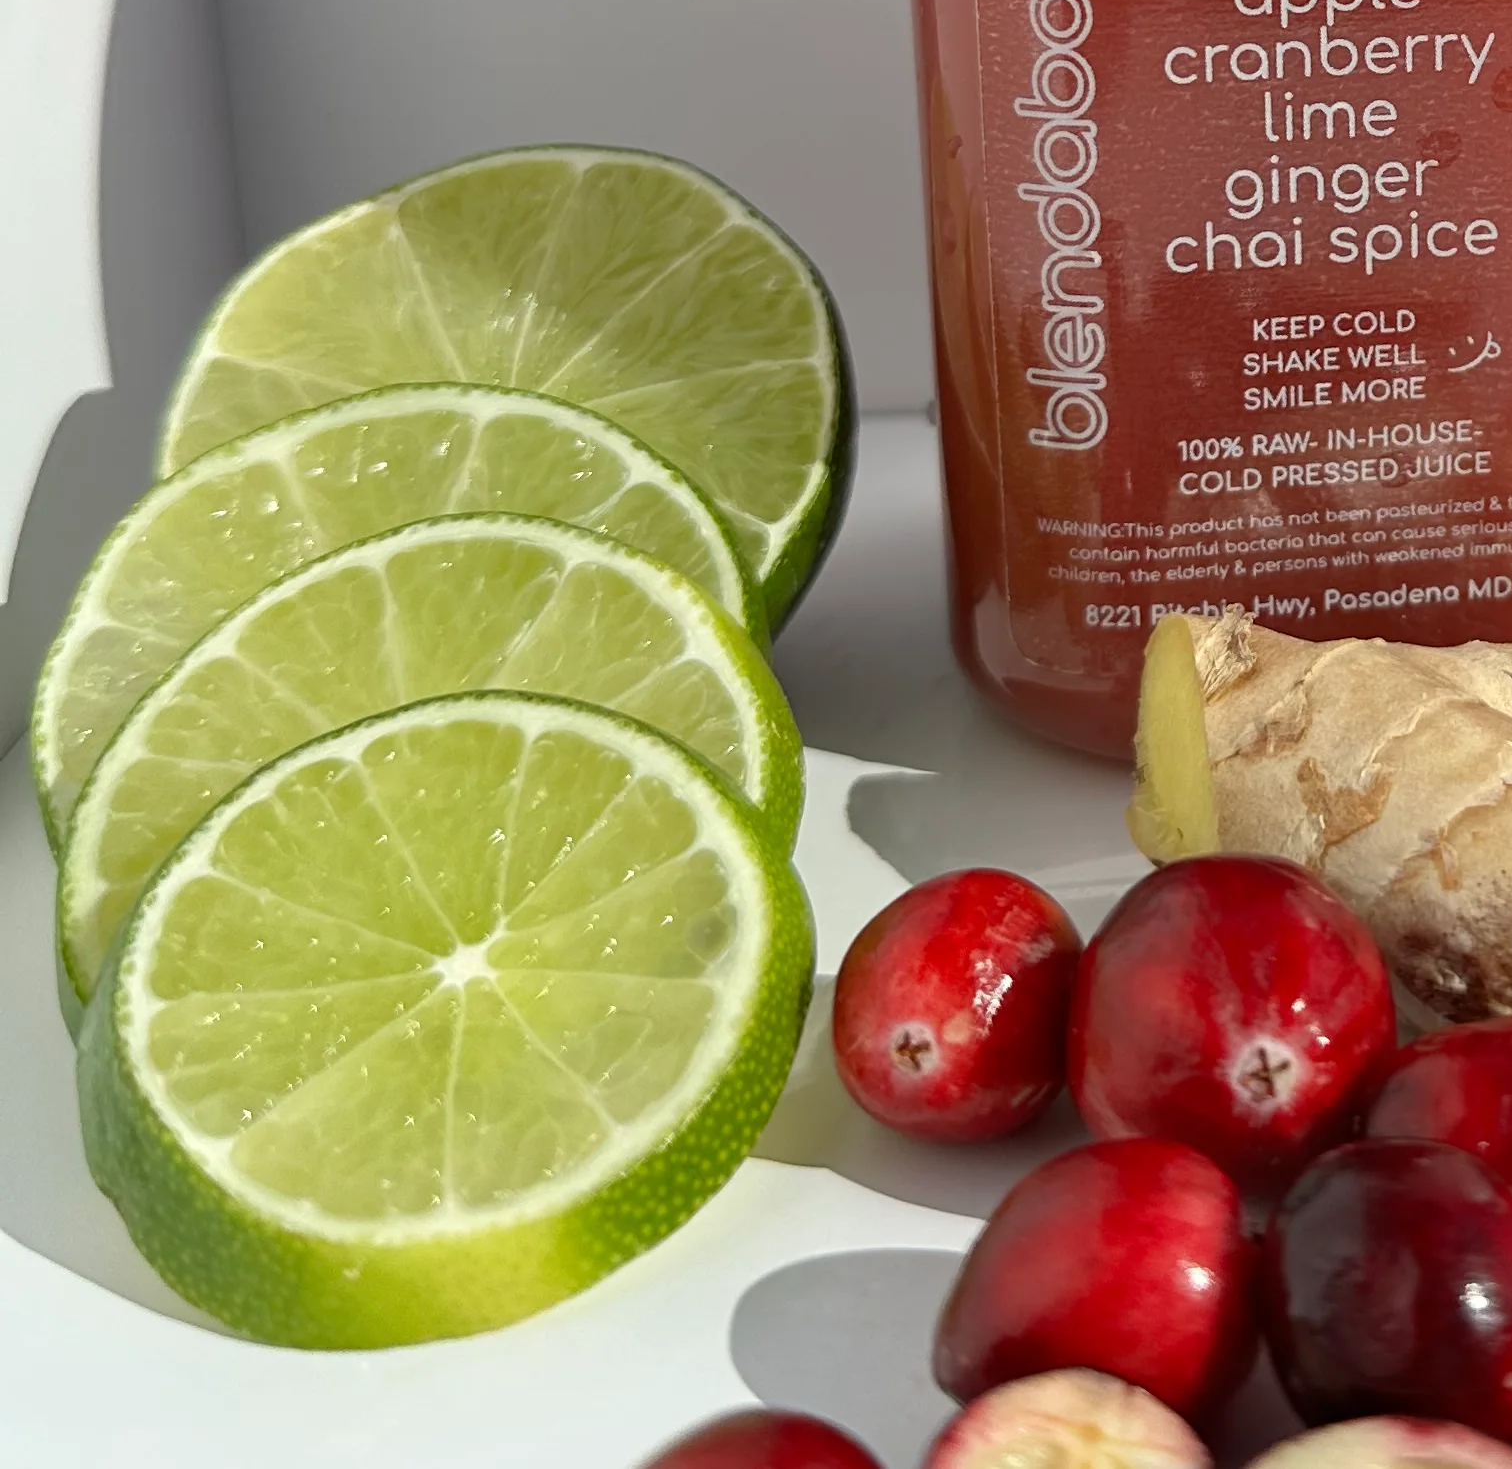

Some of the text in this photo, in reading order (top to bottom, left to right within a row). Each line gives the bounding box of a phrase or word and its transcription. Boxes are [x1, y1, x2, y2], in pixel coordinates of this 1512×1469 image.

[1164, 26, 1496, 85] cranberry
[1263, 90, 1399, 143] lime
[1224, 154, 1440, 221] ginger
[1165, 210, 1500, 276] chai spice
[1252, 308, 1417, 342] KEEP COLD
[1242, 342, 1427, 377] SHAKE WELL
[1243, 376, 1427, 411] SMILE MORE
[1177, 436, 1244, 462] 100%
[1178, 450, 1493, 496] COLD PRESSED JUICE
[1169, 517, 1244, 540] product
[1249, 512, 1284, 529] has
[1288, 510, 1319, 526] not
[1325, 507, 1372, 523] been
[1376, 497, 1485, 524] pasteurized
[1489, 495, 1502, 511] &
[1048, 564, 1126, 586] children,
[1130, 567, 1162, 582] the
[1165, 562, 1230, 580] elderly
[1234, 559, 1247, 575] &
[1252, 553, 1328, 577] persons
[1331, 549, 1370, 567] with
[1374, 542, 1465, 565] weakened
[1069, 545, 1141, 562] contain
[1145, 540, 1219, 561] harmful
[1224, 533, 1304, 555] bacteria
[1308, 531, 1348, 547] that
[1351, 530, 1387, 544] can
[1391, 524, 1446, 541] cause
[1084, 604, 1141, 628] 8221
[1254, 594, 1316, 619] Hwy,
[1324, 583, 1459, 612] Pasadena
[1467, 575, 1512, 600] MD
